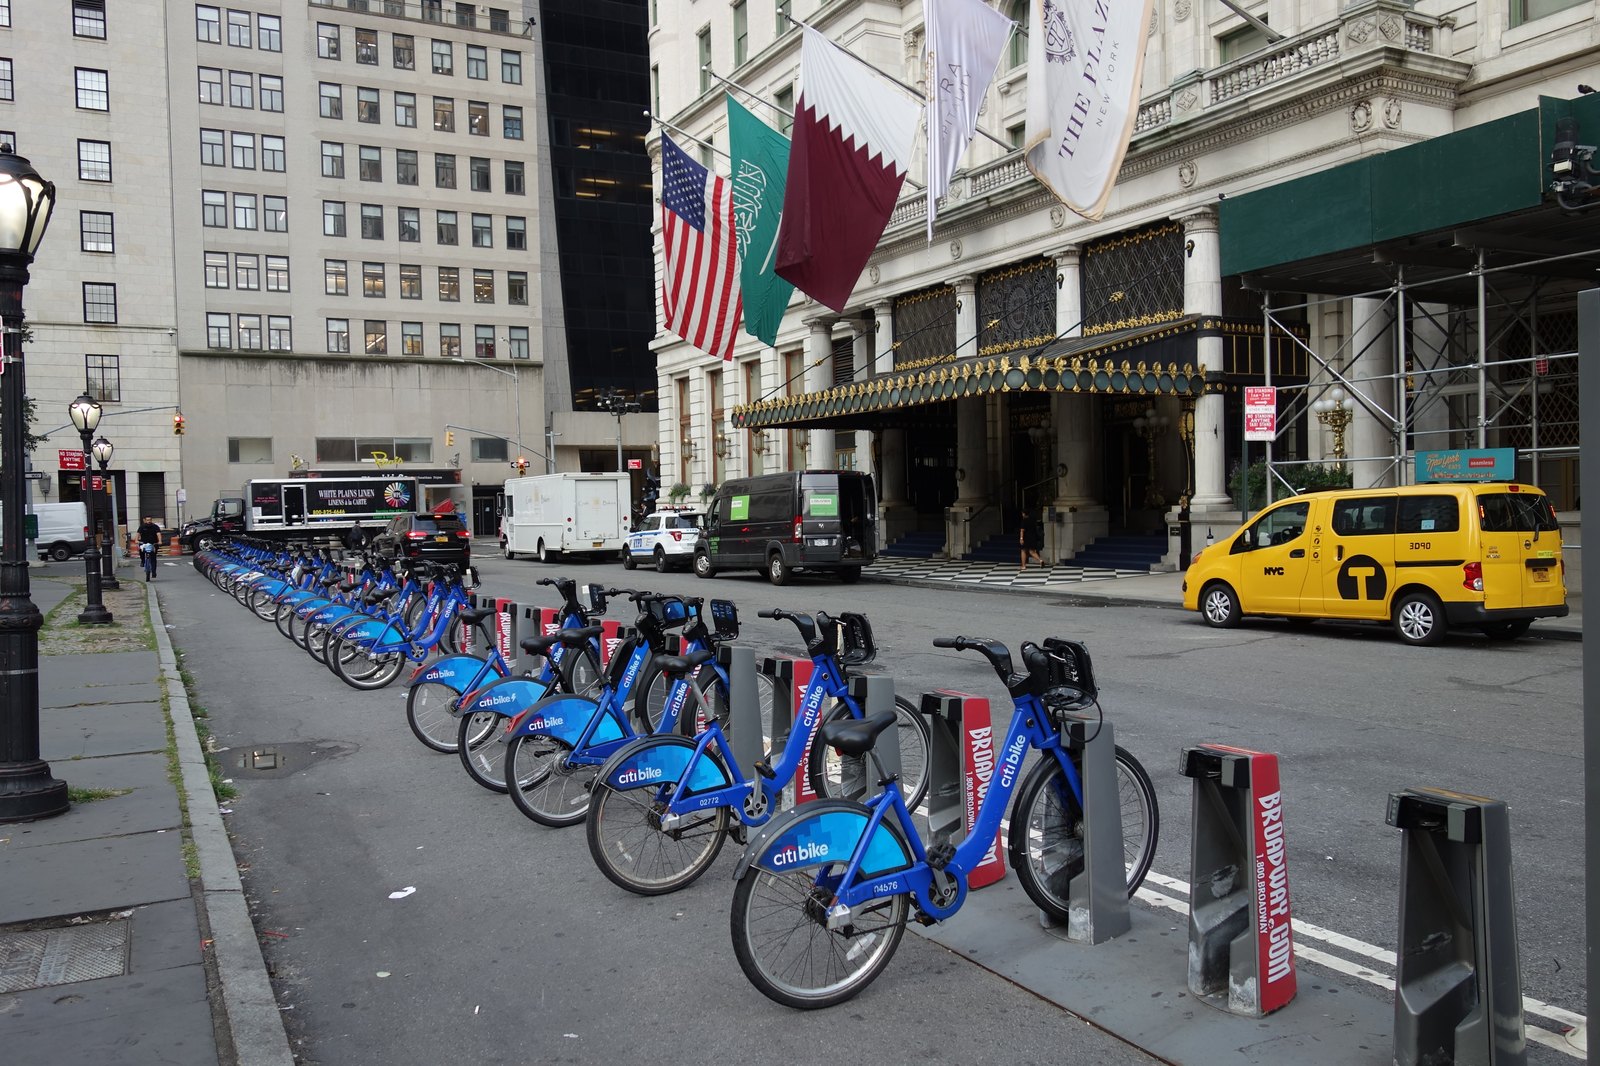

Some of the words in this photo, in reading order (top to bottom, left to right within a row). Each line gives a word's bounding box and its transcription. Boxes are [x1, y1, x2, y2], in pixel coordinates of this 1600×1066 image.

[1058, 92, 1091, 161] THE
[1083, 0, 1111, 88] PLAZ
[1096, 94, 1111, 128] NEW
[1106, 40, 1120, 82] YORK
[319, 490, 337, 498] WHITE
[338, 489, 357, 498] PLAINS
[358, 489, 375, 497] LINEN
[1264, 567, 1284, 576] NYC
[1348, 567, 1375, 600] T
[426, 671, 439, 680] citi
[439, 669, 455, 678] bike
[624, 676, 632, 688] citi
[628, 660, 640, 676] bike
[479, 698, 493, 707] citi
[493, 696, 510, 705] bike
[675, 683, 688, 703] bike
[808, 685, 823, 712] bike
[671, 702, 680, 717] citi
[804, 708, 814, 727] citi
[528, 720, 544, 731] citi
[544, 716, 563, 728] bike
[1006, 734, 1025, 765] bike
[618, 770, 637, 784] citi
[638, 767, 662, 780] bike
[1001, 764, 1016, 788] citi
[965, 771, 974, 831] 1.800.BROADWA
[774, 847, 797, 866] citi
[799, 842, 829, 861] bike
[1256, 854, 1268, 934] 1.800.BROADWAY
